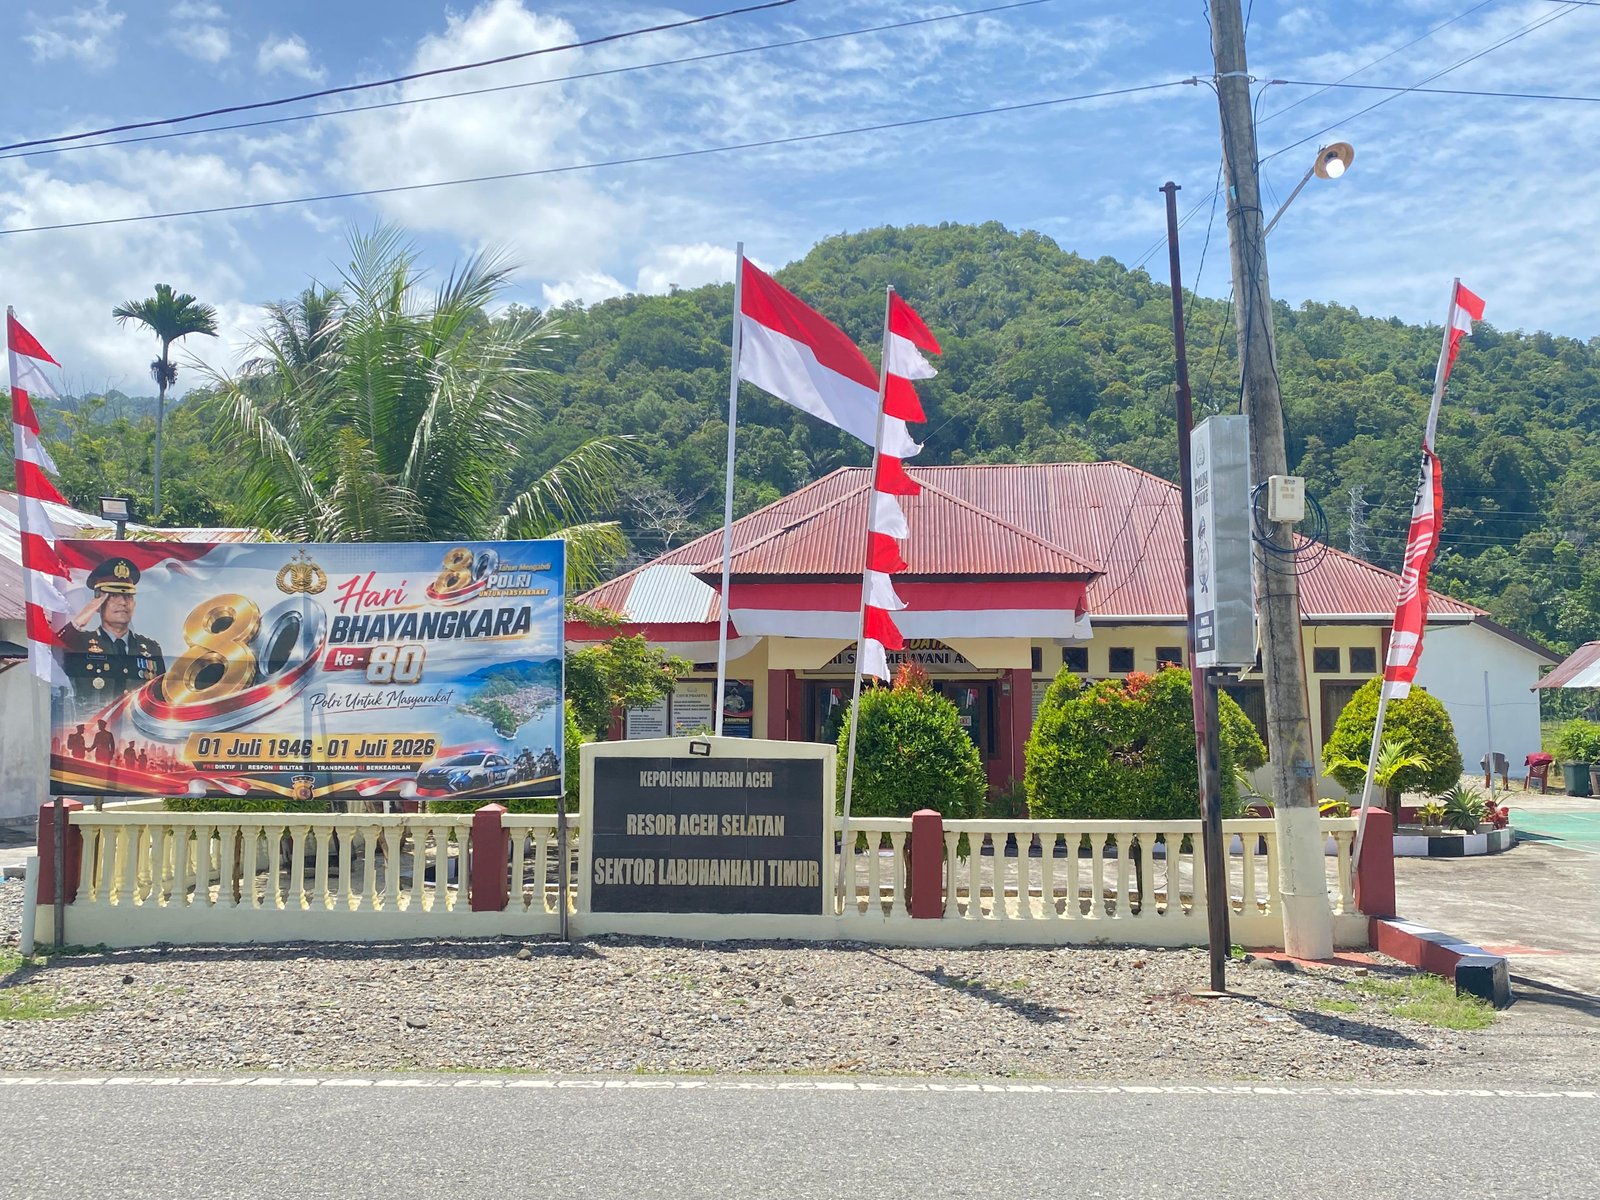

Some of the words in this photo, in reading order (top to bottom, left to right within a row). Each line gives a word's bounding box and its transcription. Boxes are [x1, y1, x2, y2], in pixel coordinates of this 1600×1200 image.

[334, 571, 408, 614] Hari
[486, 574, 532, 588] POLRI
[503, 588, 550, 597] MASYARAKAT
[328, 606, 532, 644] BHAYANGKARA
[162, 593, 327, 708] 80
[366, 645, 427, 685] 80
[309, 693, 342, 712] Polri
[345, 691, 383, 709] Untuk
[386, 689, 454, 709] Masyarakat
[198, 737, 221, 756] 01
[227, 738, 262, 756] Juli
[269, 738, 313, 757] 1946
[327, 739, 349, 757] 01
[354, 739, 388, 757] Juli
[391, 738, 435, 757] 2026
[639, 771, 700, 788] KEPOLISIAN
[703, 771, 744, 788] DAERAH
[746, 771, 773, 788] ACEH
[626, 814, 676, 836] RESOR
[679, 814, 718, 836] ACEH
[722, 815, 785, 837] SELATAN
[594, 858, 655, 886] SEKTOR
[658, 858, 764, 887] LABUHANHAJI
[768, 860, 820, 888] TIMUR
